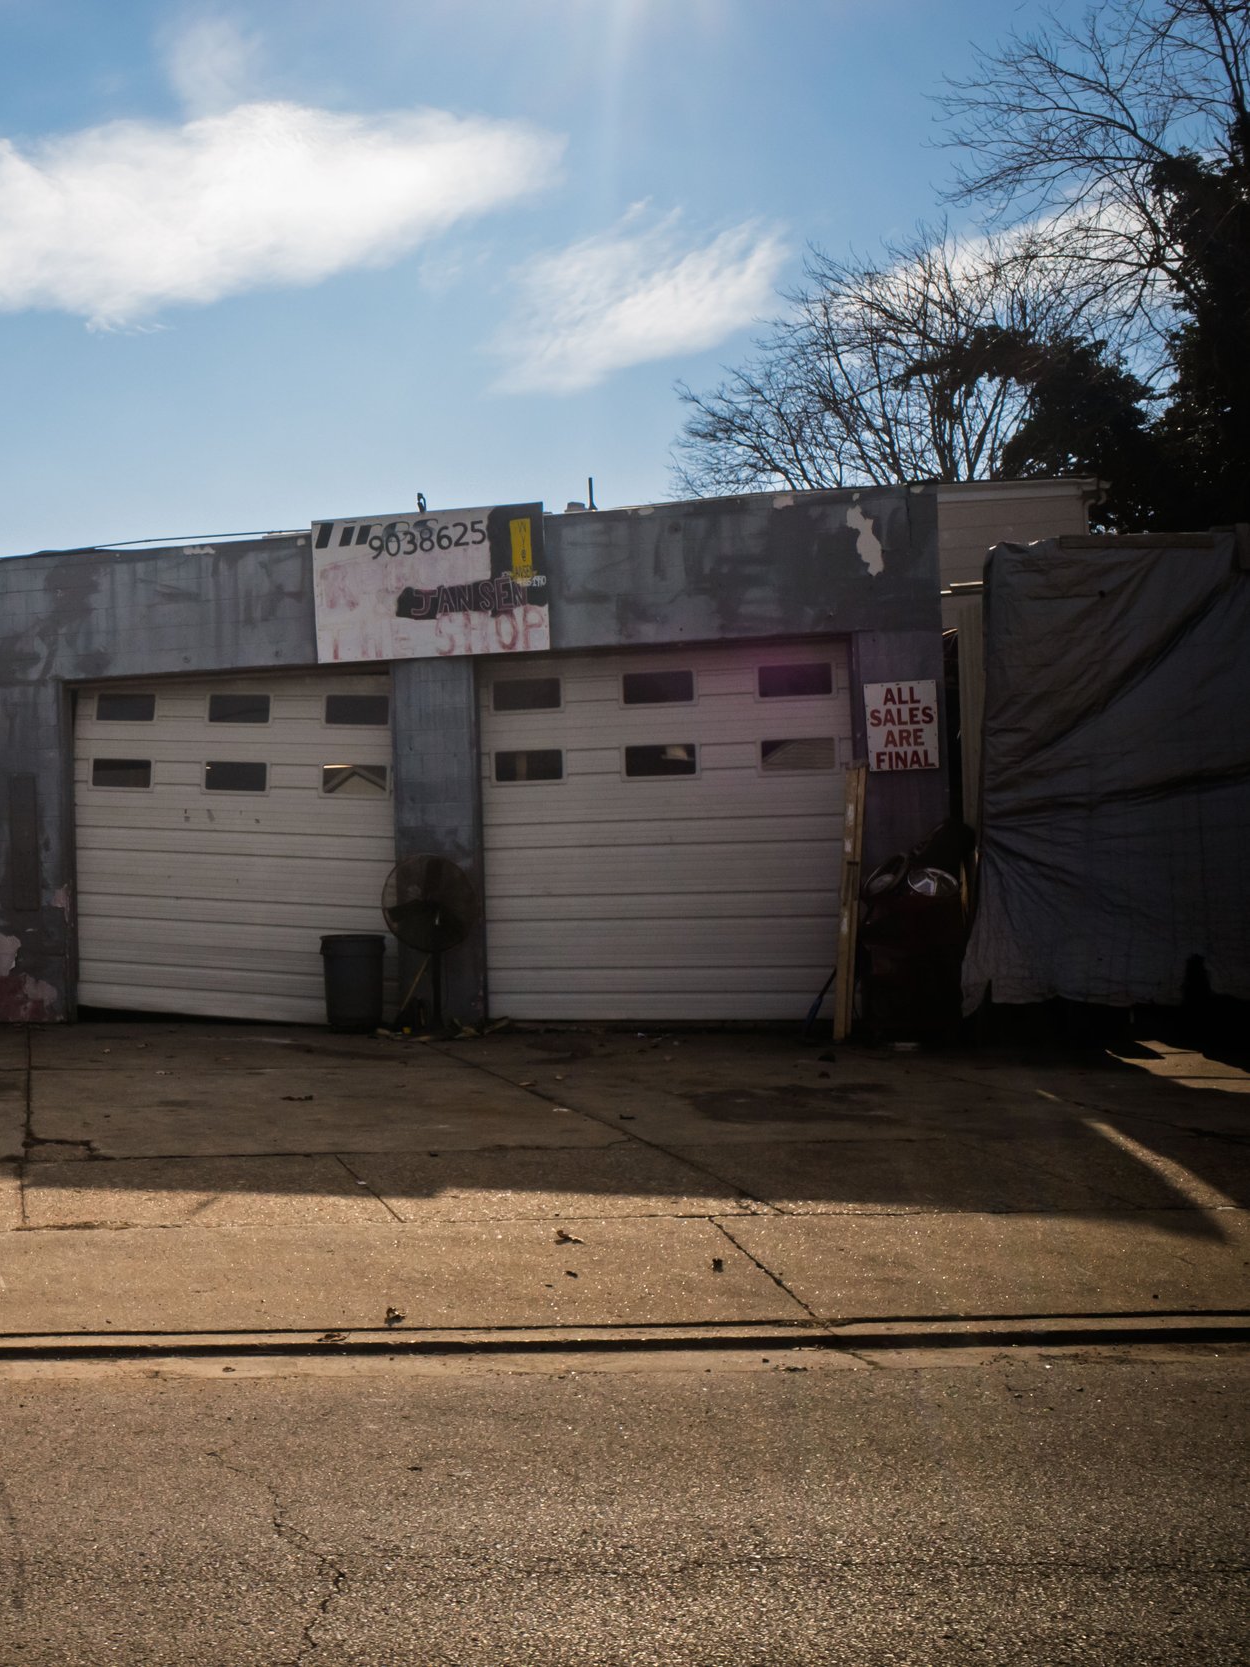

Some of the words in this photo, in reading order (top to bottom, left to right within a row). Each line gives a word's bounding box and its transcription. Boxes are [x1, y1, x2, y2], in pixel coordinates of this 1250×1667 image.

[368, 520, 487, 560] 9038625
[410, 576, 528, 617] JANSEN
[435, 605, 546, 656] SHOP
[883, 686, 921, 705] ALL
[869, 706, 934, 727] SALES
[884, 728, 925, 748] ARE
[875, 749, 936, 769] FINAL
